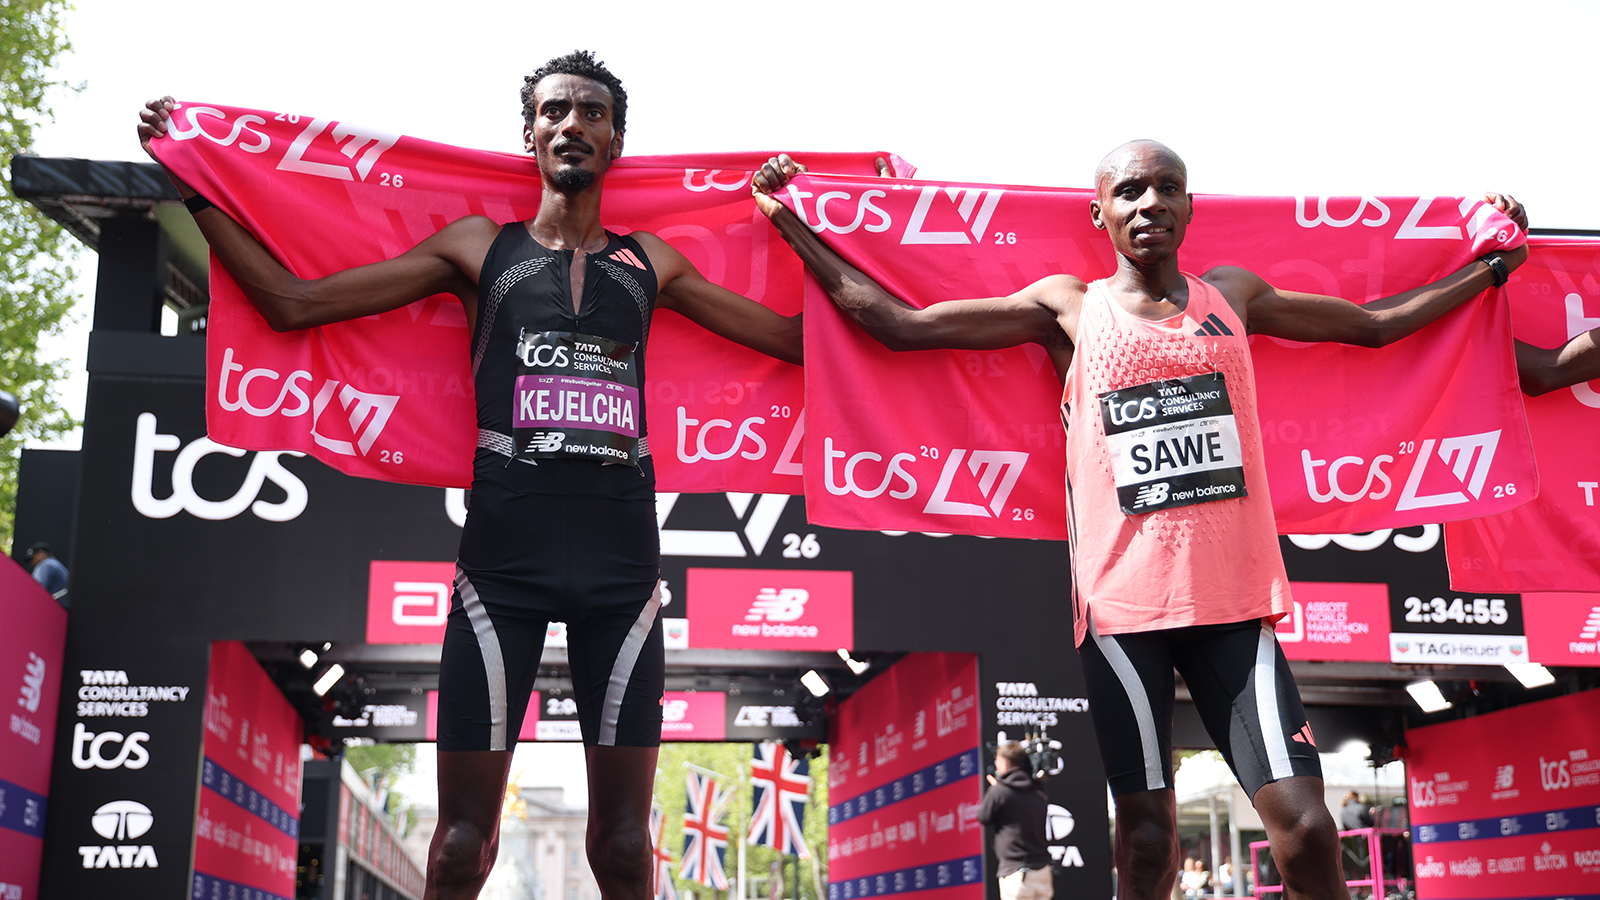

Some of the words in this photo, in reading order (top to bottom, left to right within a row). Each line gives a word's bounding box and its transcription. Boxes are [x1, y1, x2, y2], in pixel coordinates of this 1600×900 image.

[379, 172, 405, 188] 26
[786, 184, 892, 235] tcs
[994, 231, 1018, 245] 26
[1484, 227, 1508, 243] 26
[523, 341, 569, 368] tcs
[574, 342, 602, 354] TATA
[573, 352, 629, 371] CONSULTANCY
[573, 363, 612, 375] SERVICES
[1157, 385, 1187, 397] TATA
[1159, 389, 1221, 407] CONSULTANCY
[218, 347, 313, 417] tcs
[380, 450, 404, 465] 26
[520, 389, 635, 431] KEJELCHA
[1108, 396, 1157, 426] tcs
[1161, 402, 1205, 417] SERVICES
[676, 406, 767, 464] tcs
[770, 404, 791, 418] 20
[565, 443, 587, 453] new
[590, 444, 629, 460] balance
[1130, 431, 1224, 475] SAWE
[131, 412, 309, 521] tcs
[1300, 448, 1394, 504] tcs
[1398, 440, 1415, 455] 20
[1492, 482, 1517, 499] 26
[824, 436, 918, 500] tcs
[920, 445, 939, 460] 20
[1012, 508, 1035, 521] 26
[1172, 491, 1194, 502] new
[1196, 483, 1236, 498] balance
[782, 532, 821, 559] 26
[1404, 596, 1509, 625] 2:34:55
[732, 623, 761, 637] new
[762, 622, 819, 639] balance
[1569, 642, 1597, 653] new
[80, 670, 129, 685] TATA
[78, 686, 190, 701] CONSULTANCY
[995, 682, 1038, 697] TATA
[76, 701, 149, 717] SERVICES
[996, 697, 1089, 712] CONSULTANCY
[997, 711, 1058, 727] SERVICES
[72, 722, 150, 770] tcs
[1539, 755, 1570, 791] tcs
[78, 845, 159, 869] TATA
